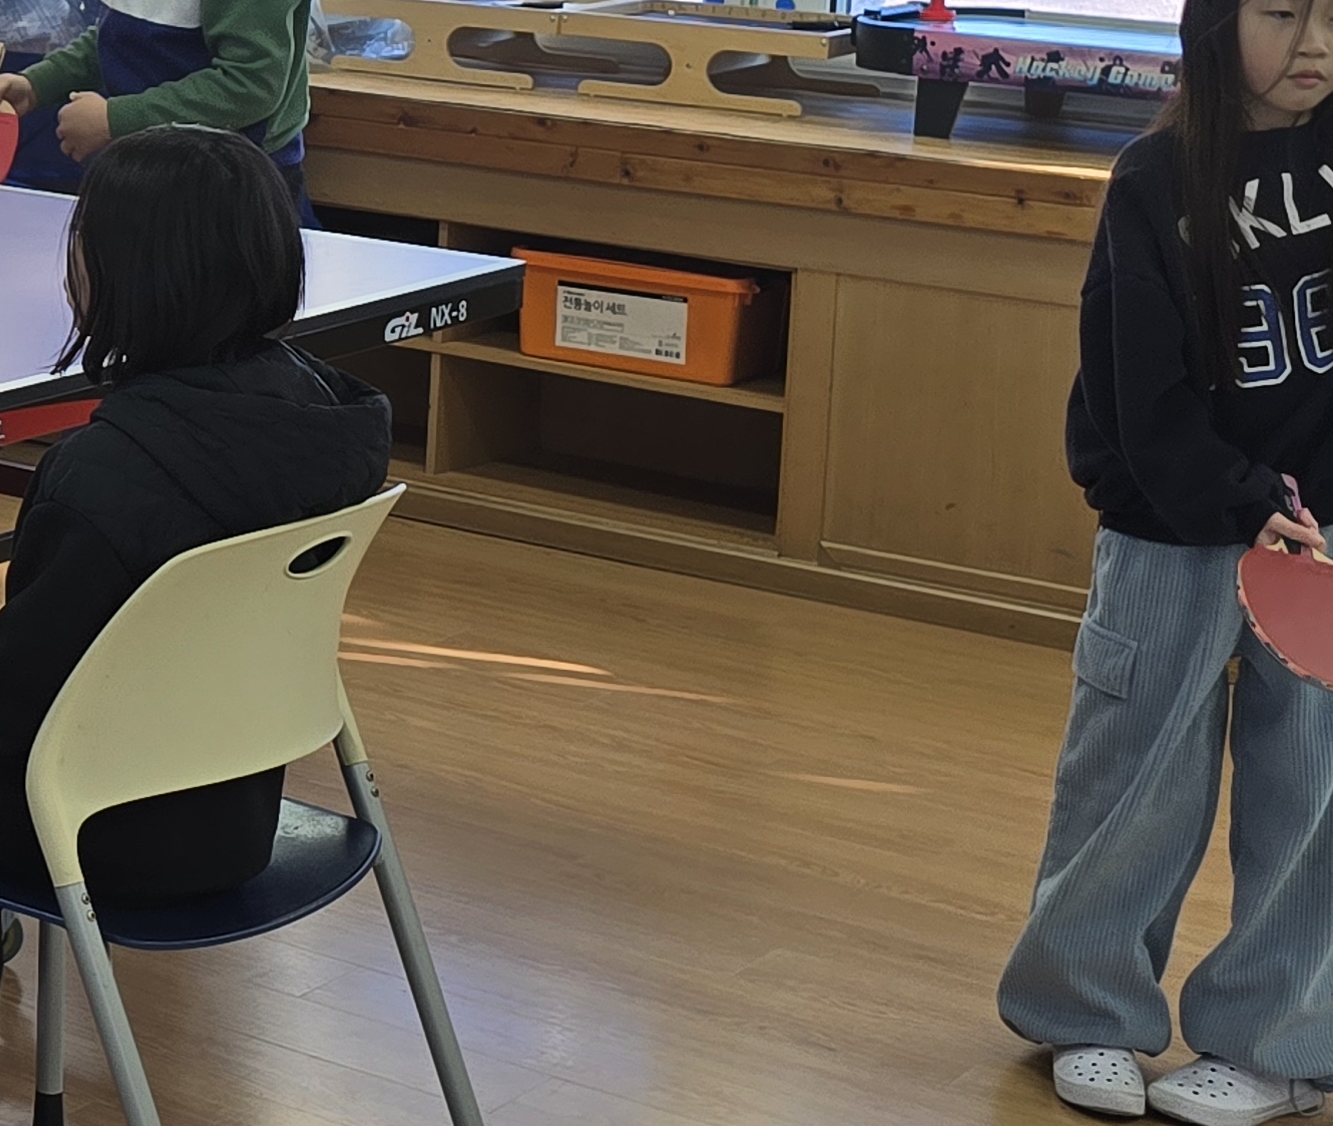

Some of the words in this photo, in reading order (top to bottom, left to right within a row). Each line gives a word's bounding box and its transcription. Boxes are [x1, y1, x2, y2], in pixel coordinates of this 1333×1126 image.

[1016, 57, 1101, 86] Hockey
[1108, 66, 1176, 90] Game
[430, 300, 467, 329] NX-8
